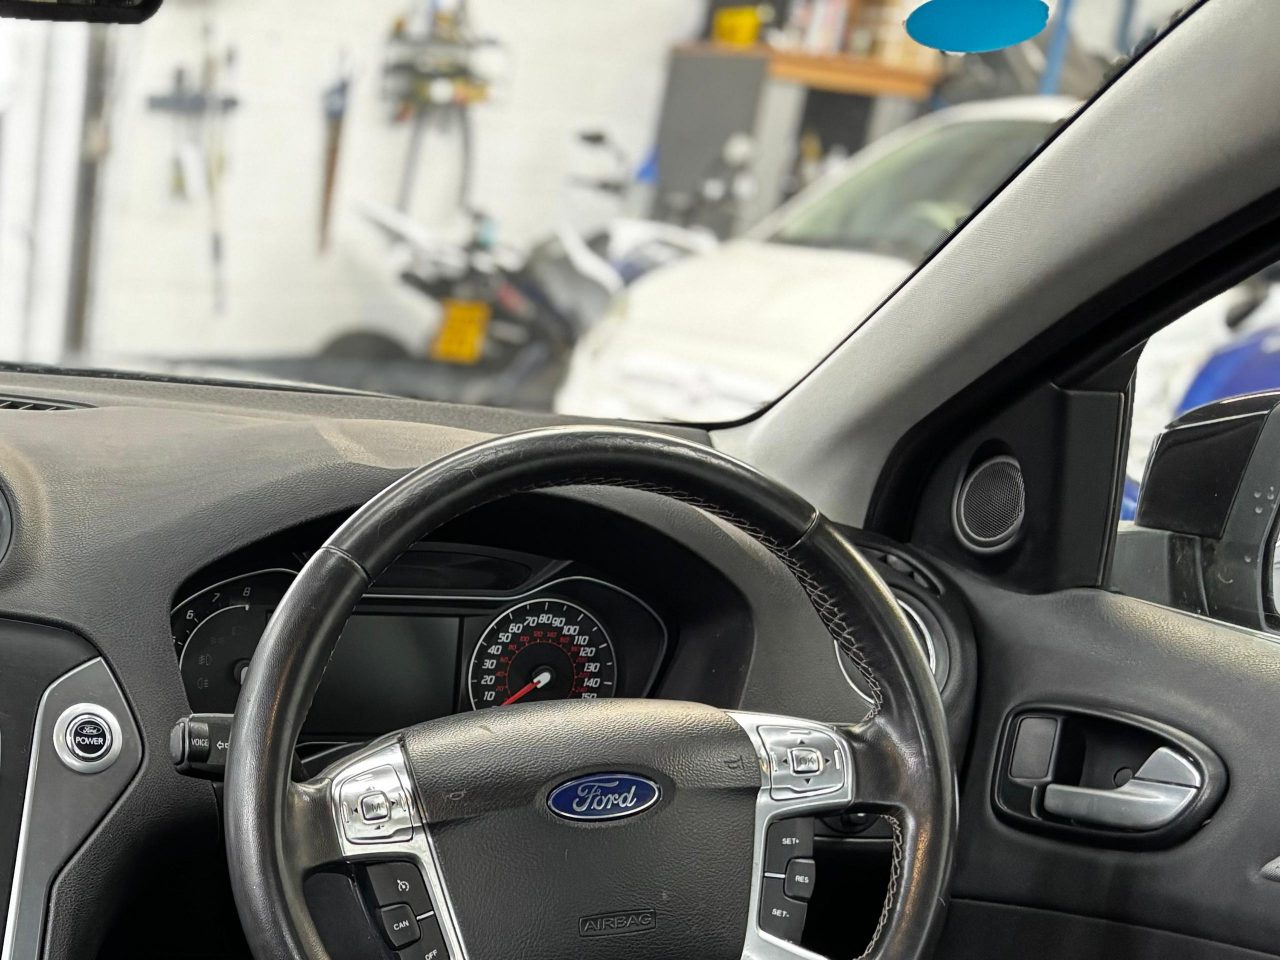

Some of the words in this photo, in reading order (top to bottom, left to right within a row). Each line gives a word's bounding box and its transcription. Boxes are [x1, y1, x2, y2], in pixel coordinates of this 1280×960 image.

[243, 587, 251, 597] 8
[212, 593, 220, 602] 7
[186, 610, 194, 620] 6
[538, 613, 552, 624] 80
[523, 616, 538, 627] 70
[552, 617, 566, 627] 90
[508, 623, 523, 633] 60
[562, 625, 579, 635] 100
[498, 633, 512, 643] 50
[573, 635, 589, 646] 110
[488, 645, 502, 655] 40
[579, 647, 596, 657] 120
[482, 659, 496, 669] 30
[583, 663, 601, 672] 130
[481, 675, 495, 685] 20
[583, 678, 601, 688] 140
[484, 691, 495, 700] 10
[75, 736, 104, 745] POWER
[191, 738, 209, 747] VOICE
[572, 780, 637, 812] Ford
[795, 875, 809, 883] RES
[393, 920, 409, 930] CAN
[584, 913, 652, 932] AIRBAG
[425, 949, 437, 960] OFF
